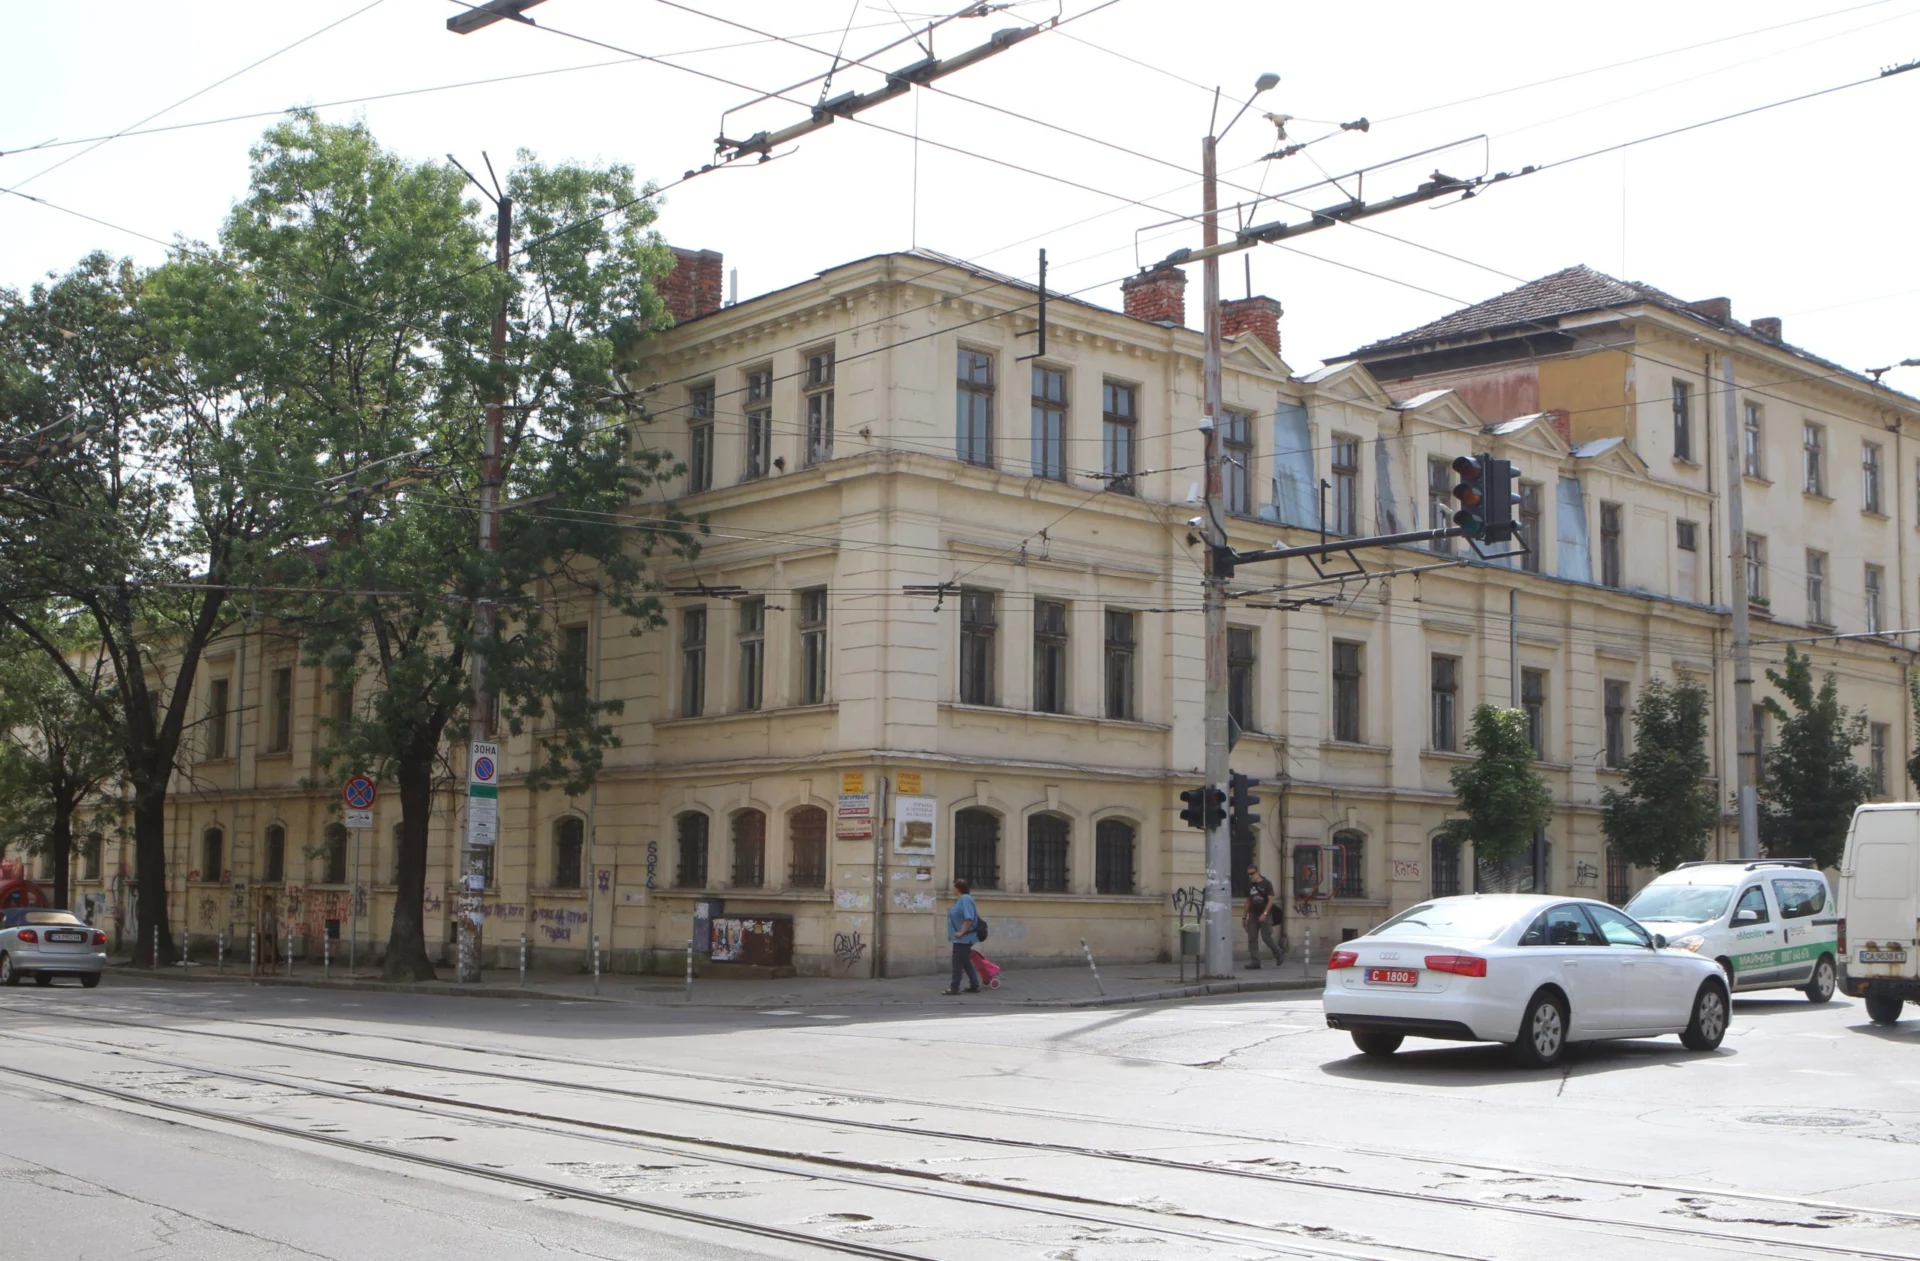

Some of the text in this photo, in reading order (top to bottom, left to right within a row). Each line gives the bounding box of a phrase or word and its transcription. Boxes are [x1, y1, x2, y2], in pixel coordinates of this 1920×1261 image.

[474, 744, 497, 755] ЗОНА
[1736, 929, 1766, 941] eMobility
[1740, 951, 1776, 965] МАЙНИНГ
[1372, 970, 1409, 982] C 1800
